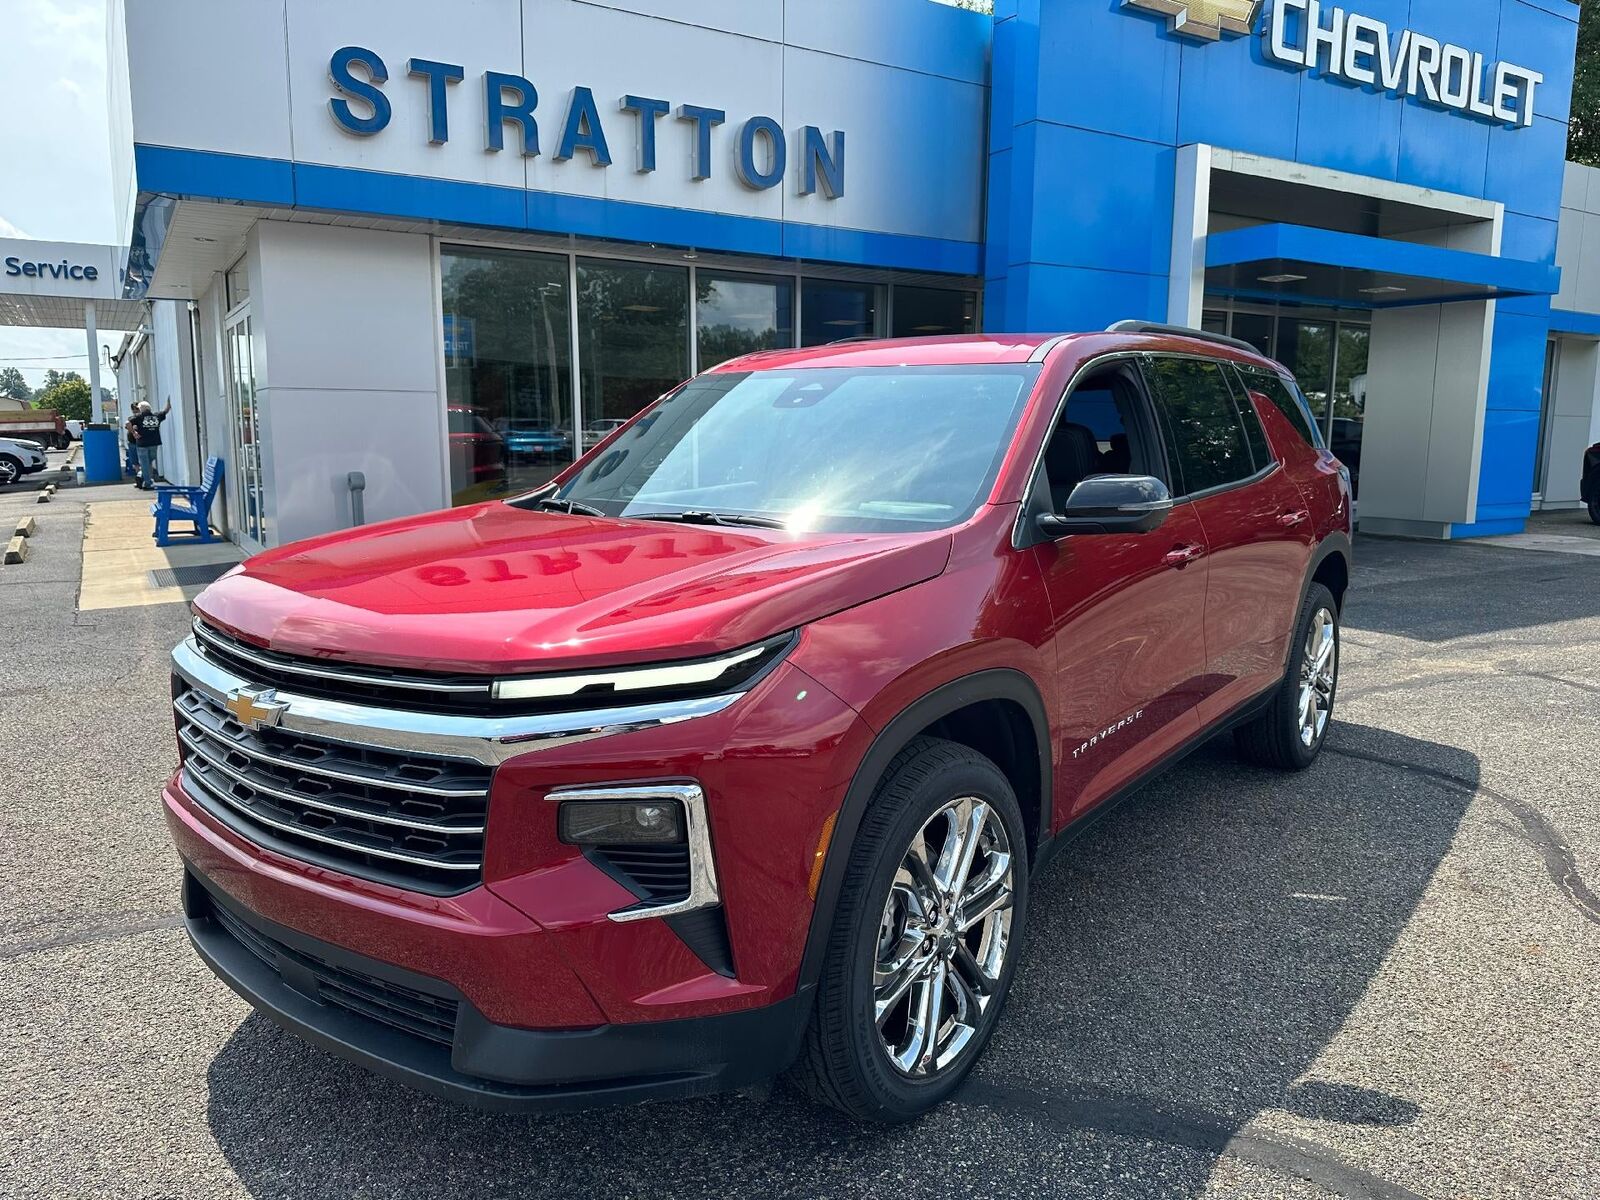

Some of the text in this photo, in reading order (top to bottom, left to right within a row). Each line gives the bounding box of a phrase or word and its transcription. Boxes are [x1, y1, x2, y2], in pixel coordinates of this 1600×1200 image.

[1270, 0, 1543, 127] CHEVROLET
[327, 46, 845, 199] STRATTON
[5, 257, 98, 281] Service
[1072, 709, 1143, 759] TRAVERSE
